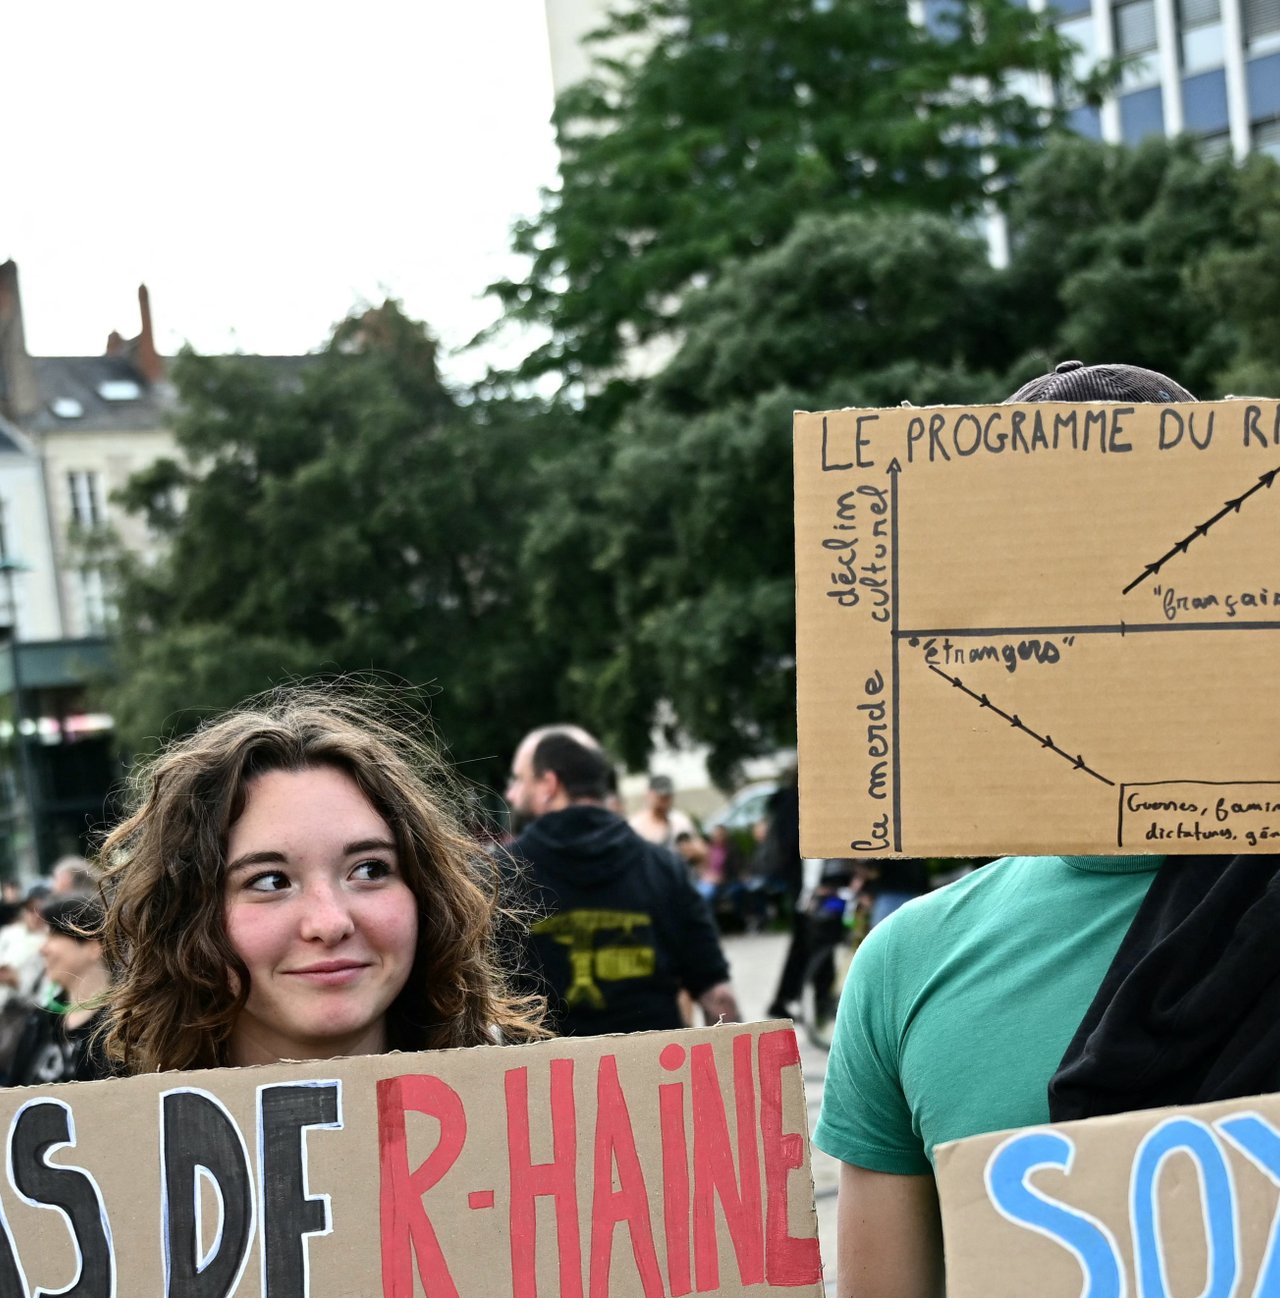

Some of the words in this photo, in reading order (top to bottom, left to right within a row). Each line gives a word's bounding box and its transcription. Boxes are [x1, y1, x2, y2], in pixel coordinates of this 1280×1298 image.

[821, 415, 880, 471] LE
[906, 407, 1136, 464] PROGRAMME
[1159, 410, 1215, 450] DU
[822, 490, 860, 607] déclin
[857, 485, 891, 622] culturel
[856, 669, 889, 800] merde
[851, 813, 890, 852] la
